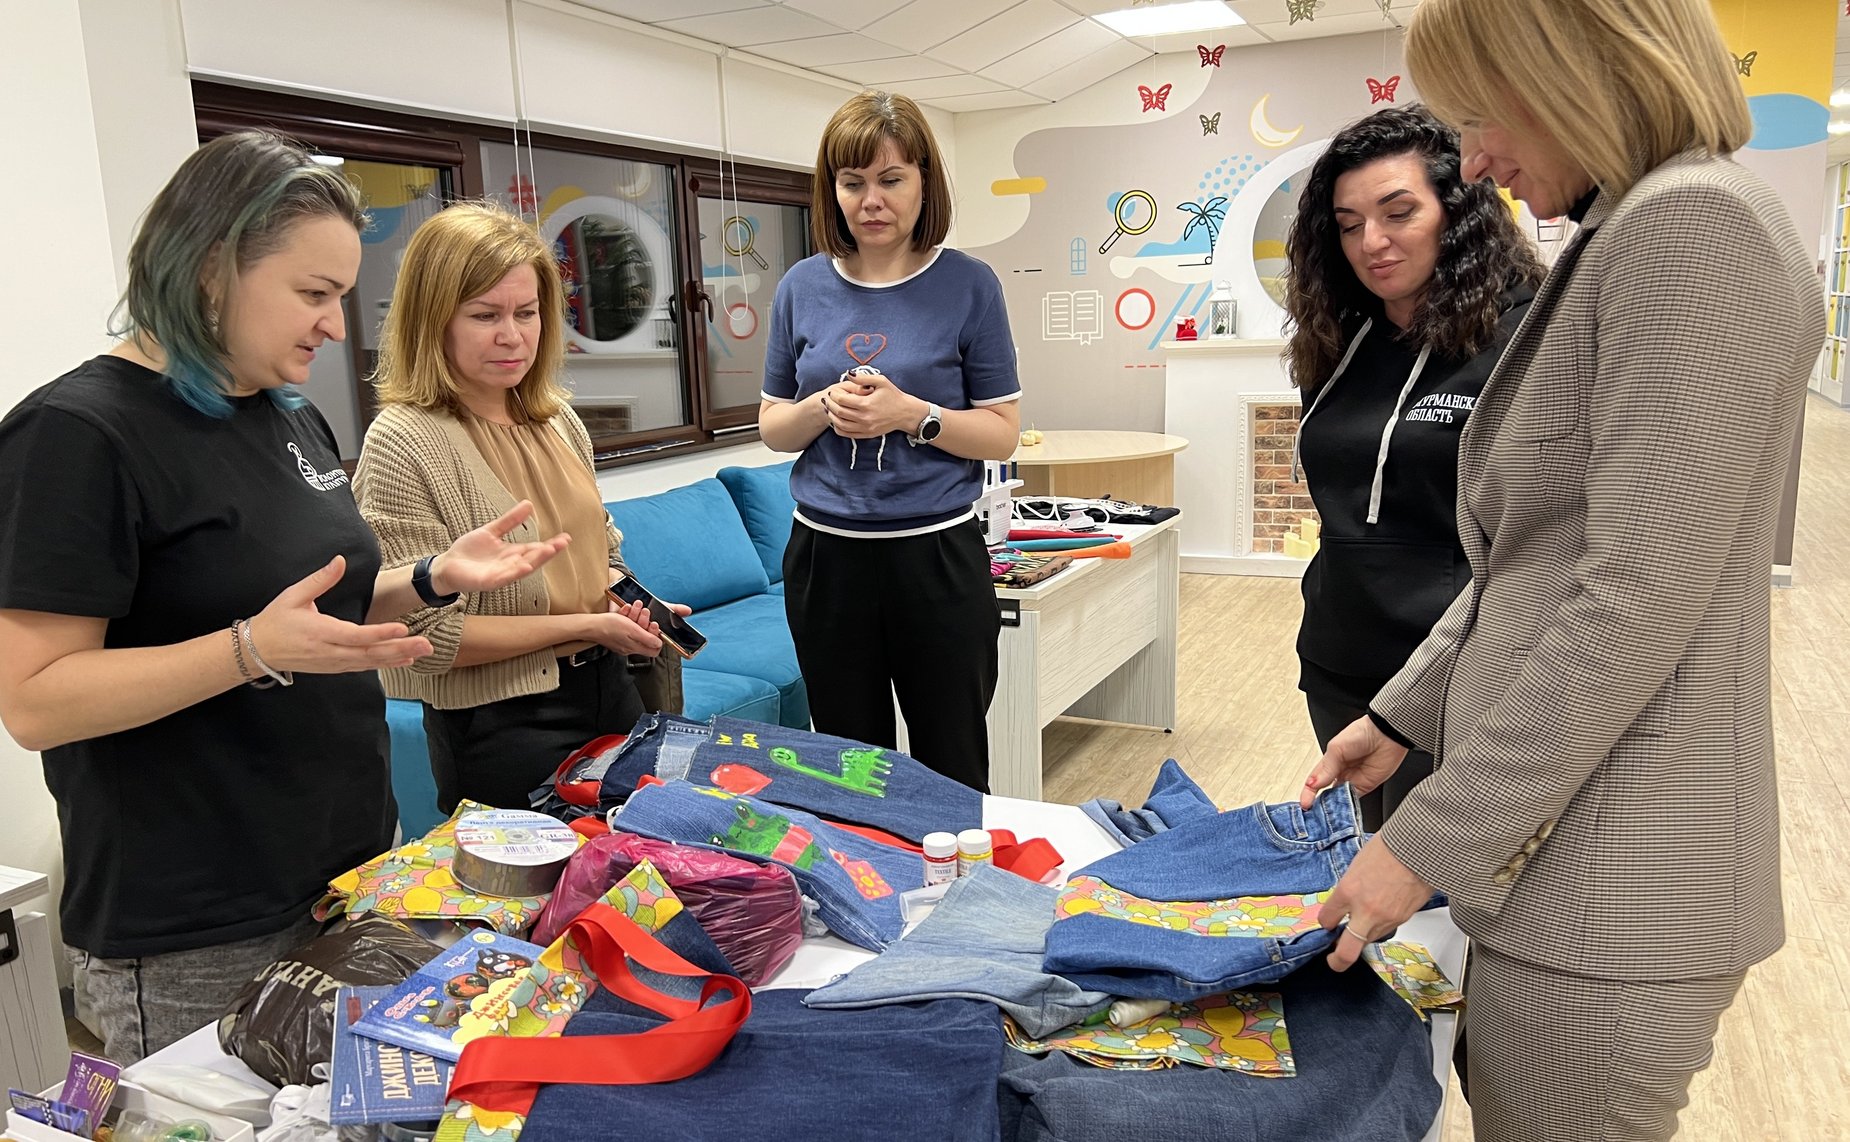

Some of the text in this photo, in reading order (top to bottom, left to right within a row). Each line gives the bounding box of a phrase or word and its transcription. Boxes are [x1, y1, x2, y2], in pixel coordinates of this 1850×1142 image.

[1412, 393, 1476, 411] УРМАНСК
[1405, 408, 1453, 424] ОБЛАСТЬ
[377, 1042, 413, 1099] ДЖИНС
